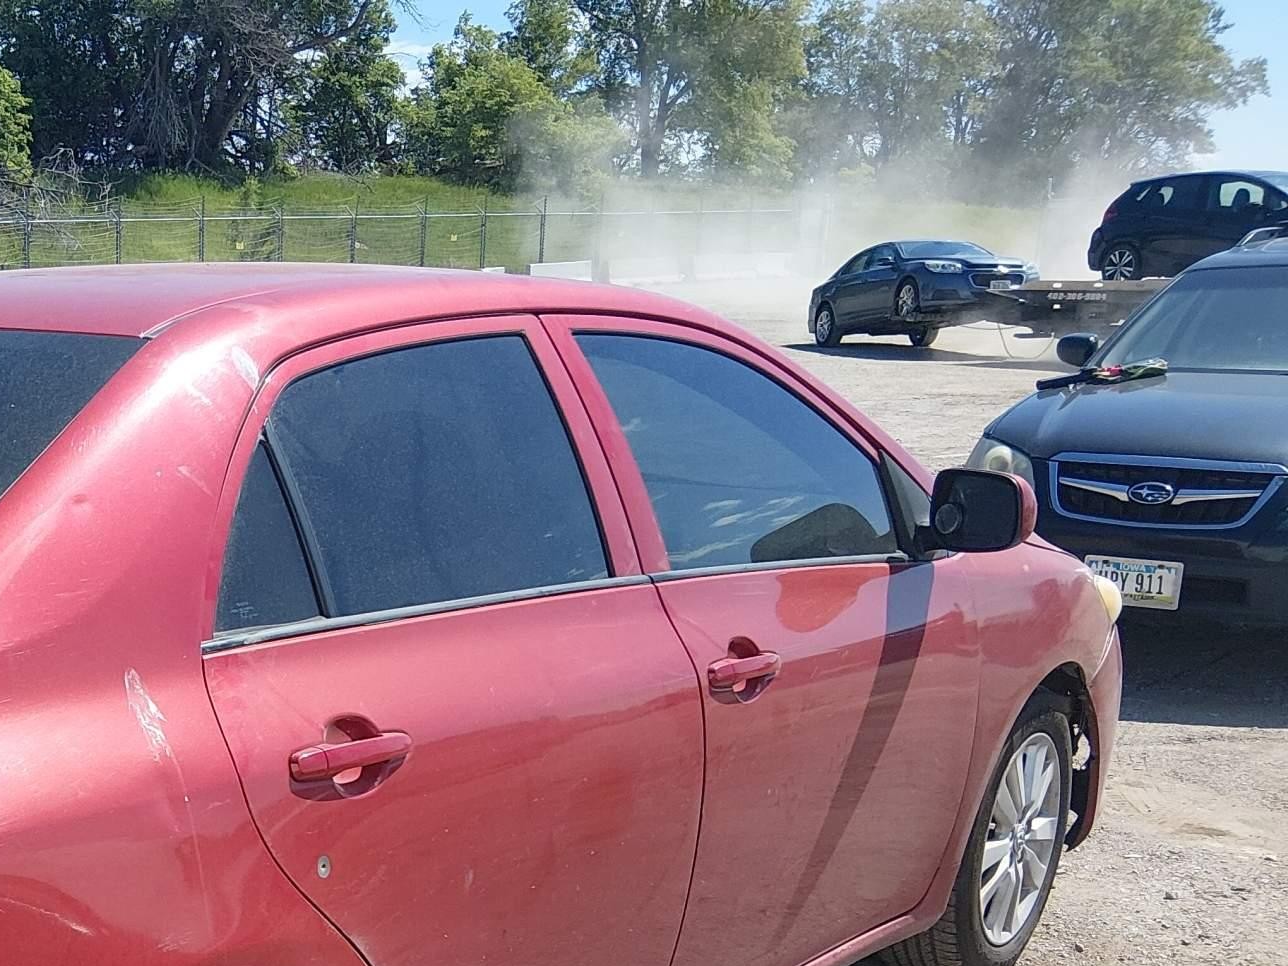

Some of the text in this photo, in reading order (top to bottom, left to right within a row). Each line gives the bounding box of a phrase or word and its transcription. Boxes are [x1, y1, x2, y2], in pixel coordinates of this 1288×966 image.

[1119, 562, 1146, 573] IOWA
[1098, 570, 1164, 594] PY 911
